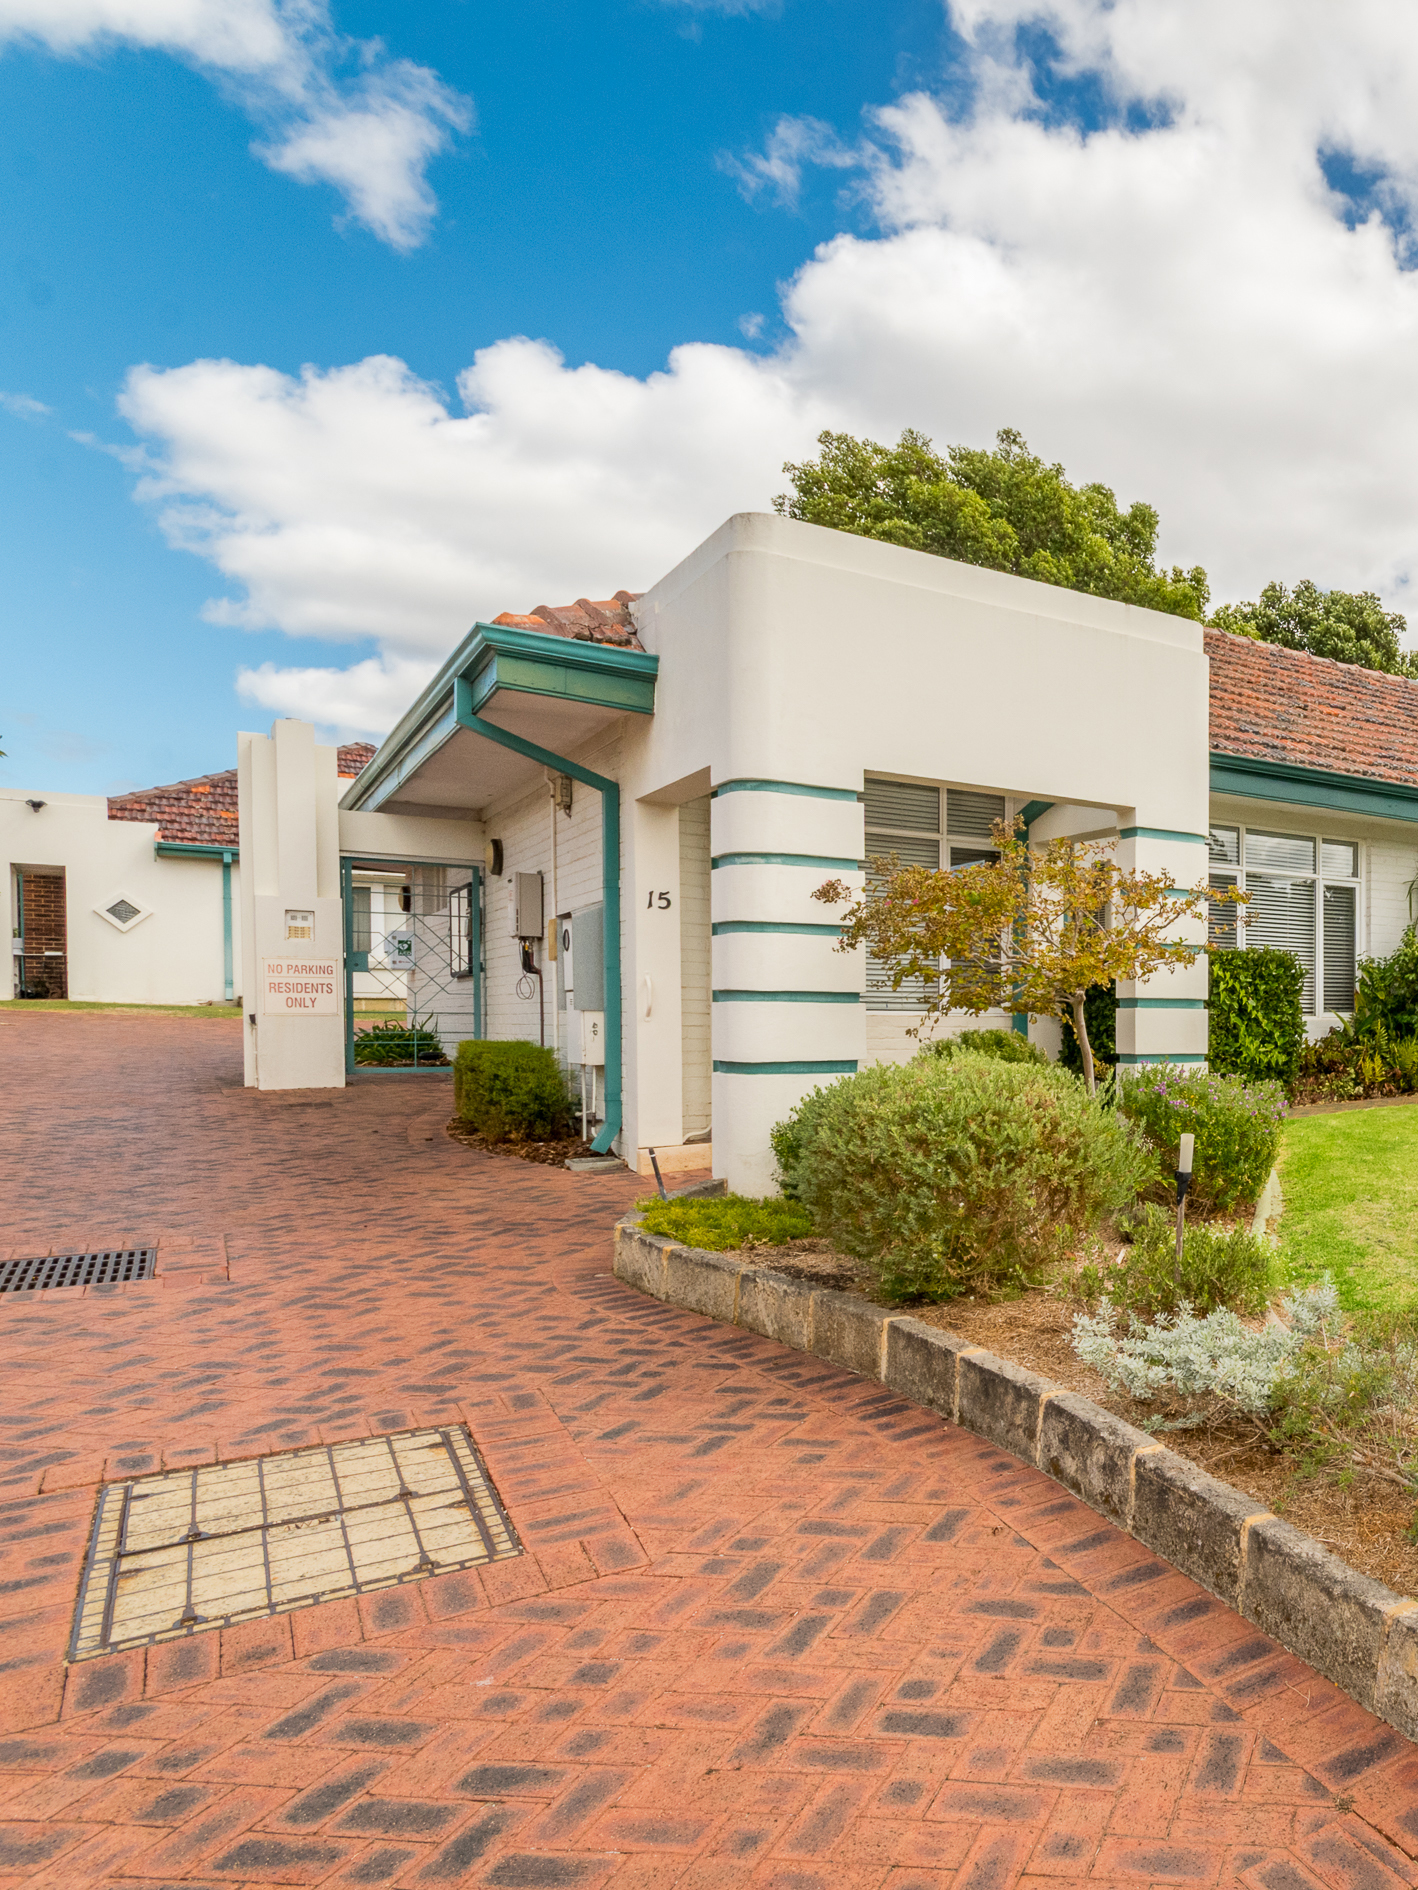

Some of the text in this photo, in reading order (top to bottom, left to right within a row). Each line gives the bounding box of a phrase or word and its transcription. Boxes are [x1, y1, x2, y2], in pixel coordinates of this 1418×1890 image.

[647, 890, 671, 910] 15
[268, 964, 333, 975] NO PARKING
[269, 983, 333, 993] RESIDENTS
[286, 997, 317, 1008] ONLY
